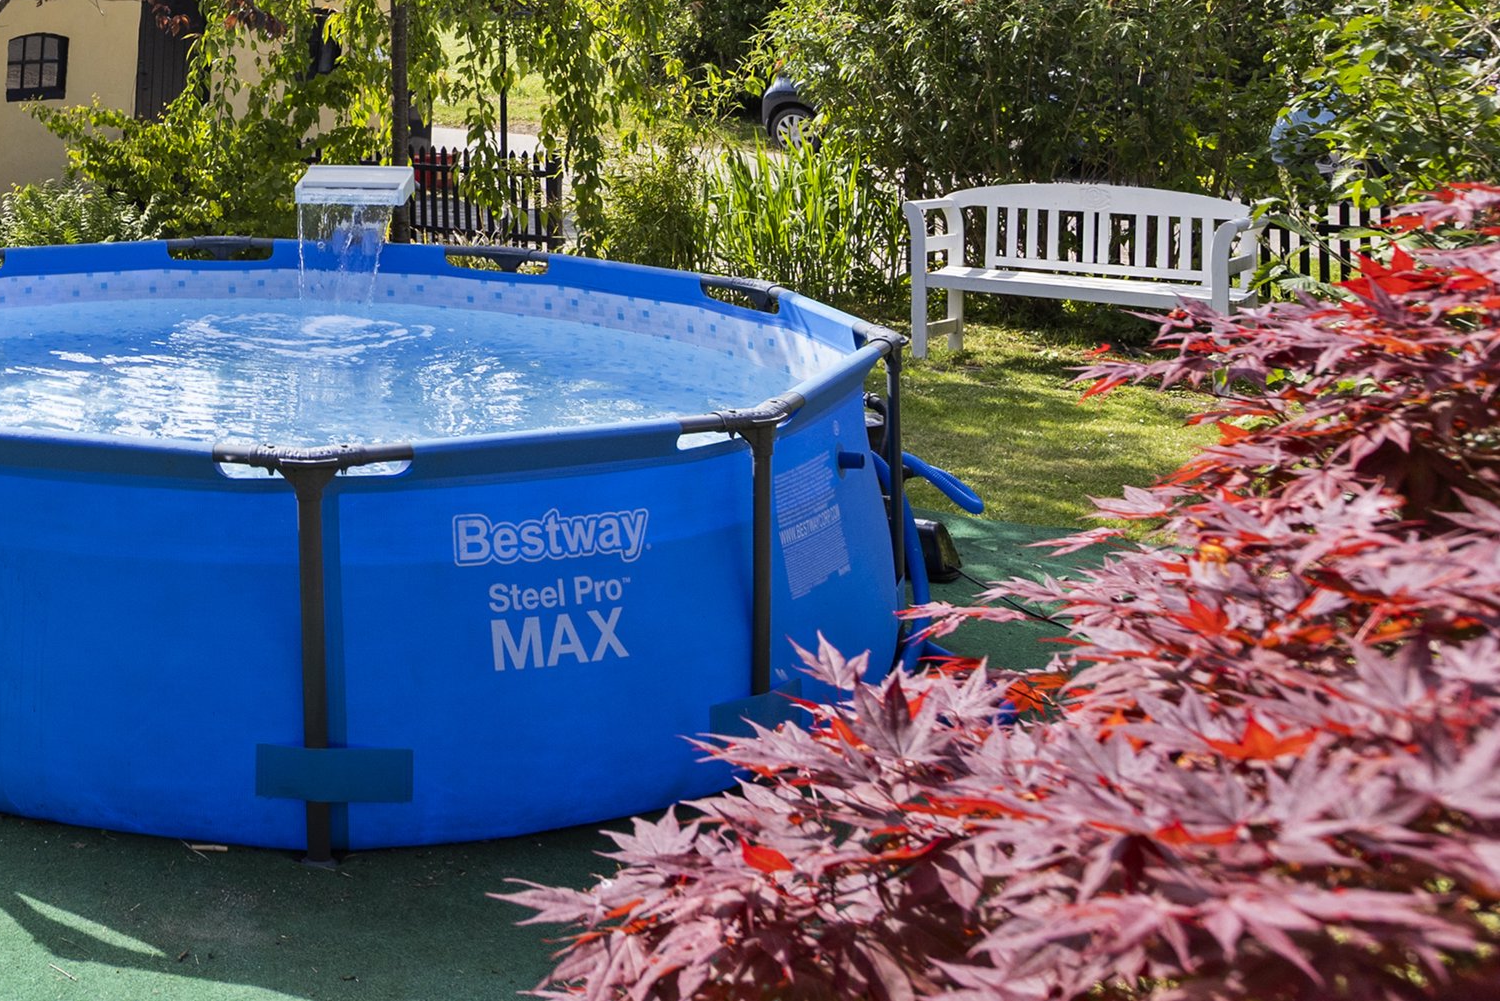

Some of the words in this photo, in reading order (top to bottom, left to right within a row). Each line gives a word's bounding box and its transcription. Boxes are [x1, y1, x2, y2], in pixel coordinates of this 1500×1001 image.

[453, 508, 649, 566] Bestway
[489, 578, 565, 612] Steel
[490, 606, 630, 671] MAX
